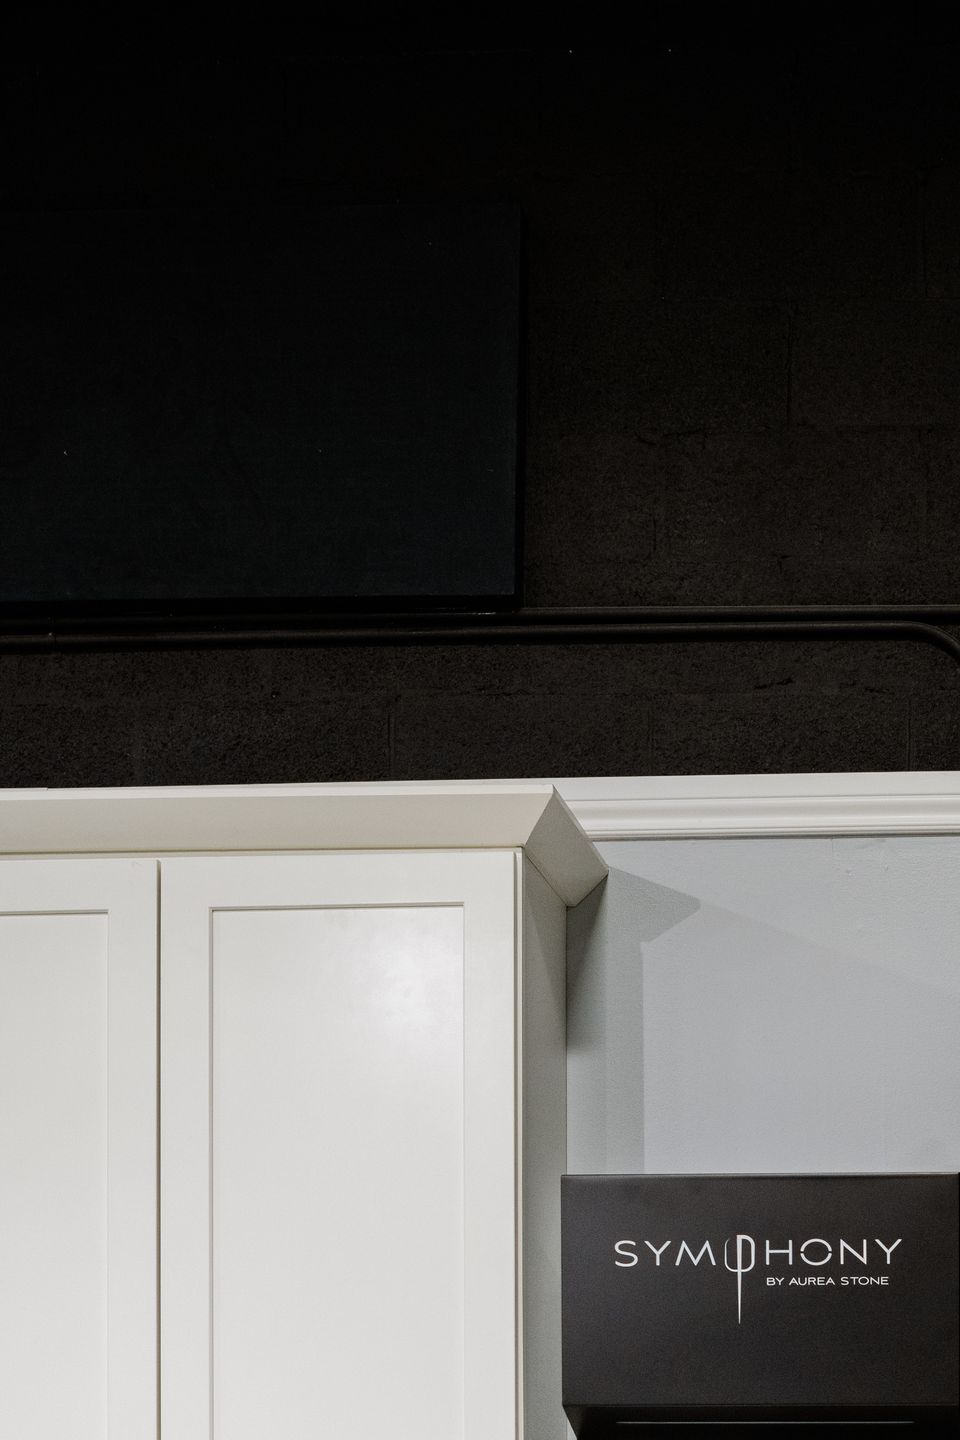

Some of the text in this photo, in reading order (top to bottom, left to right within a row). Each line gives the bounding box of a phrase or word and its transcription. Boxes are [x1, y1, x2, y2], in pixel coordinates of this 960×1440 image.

[766, 1276, 889, 1286] BY AUREA STONE
